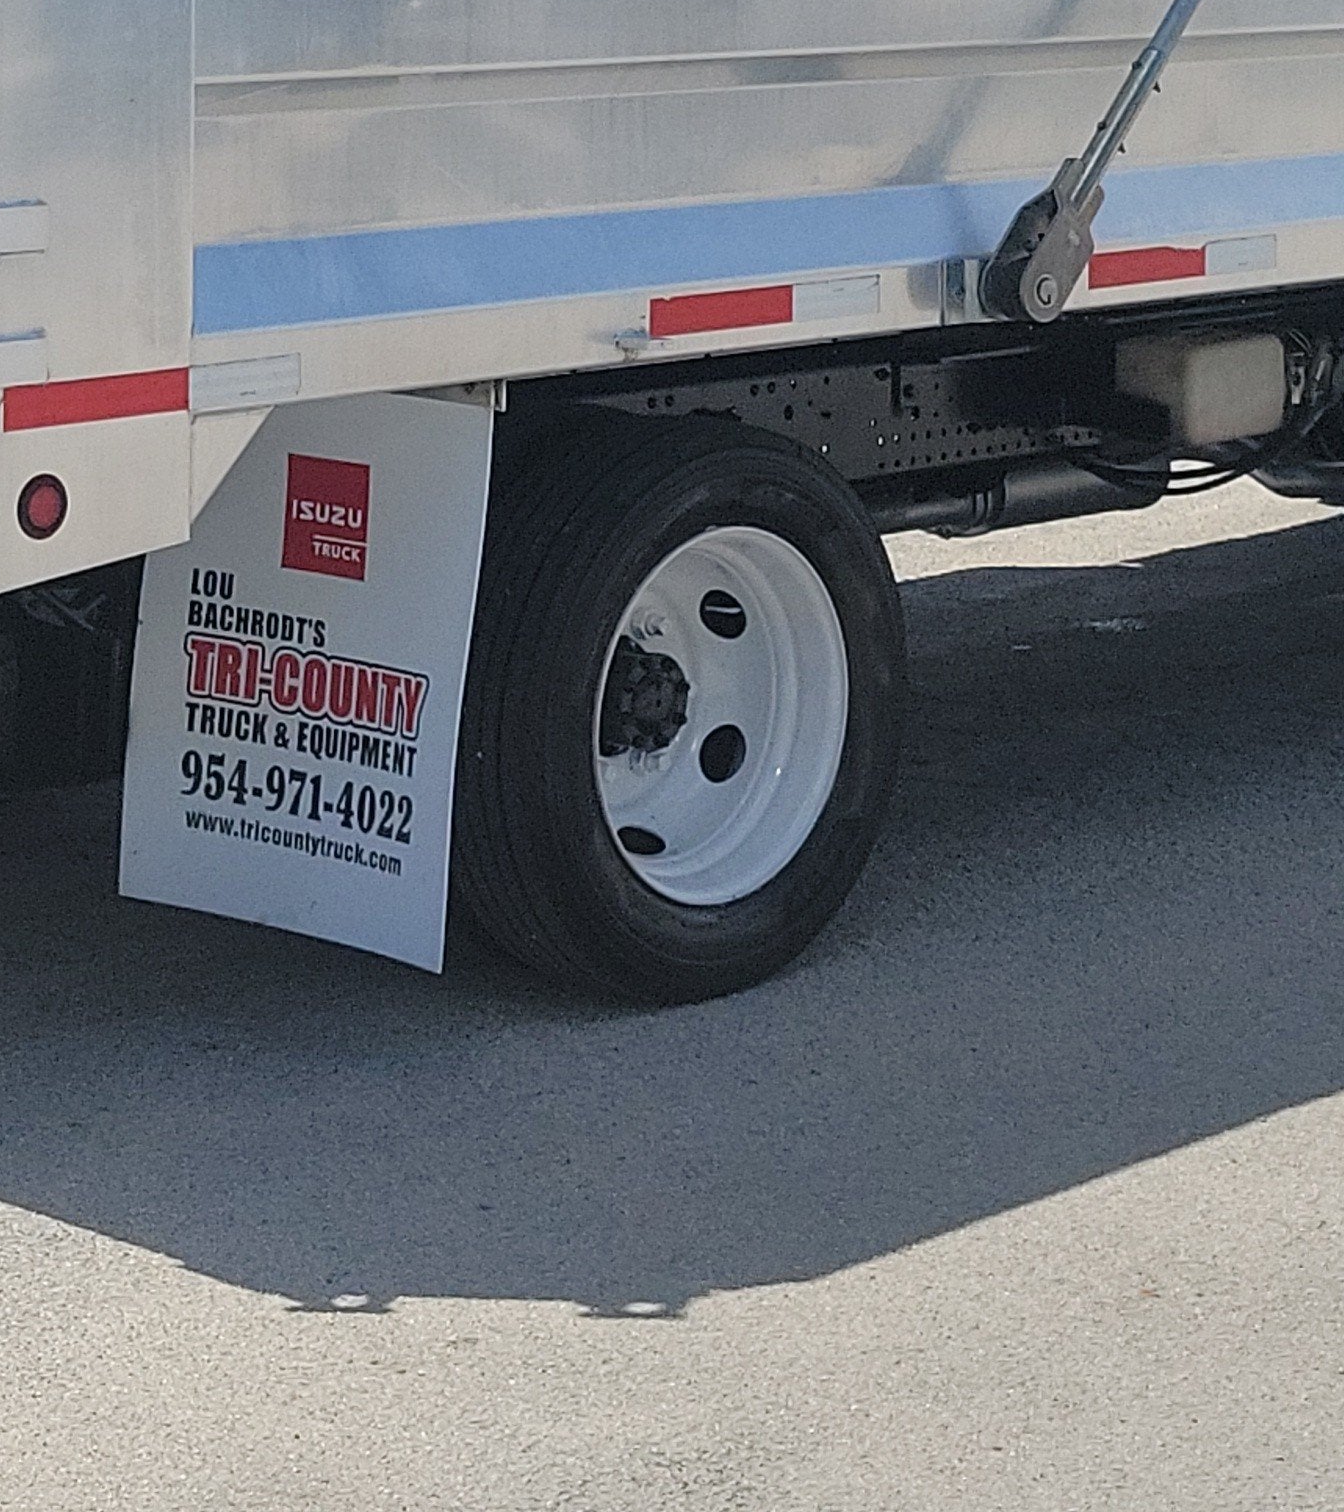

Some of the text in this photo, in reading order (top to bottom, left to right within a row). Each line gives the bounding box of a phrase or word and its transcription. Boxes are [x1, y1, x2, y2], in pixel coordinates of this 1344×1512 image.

[291, 499, 363, 528] ISUZU
[312, 541, 361, 563] TRUCK
[190, 568, 235, 600] LOU
[187, 599, 326, 648] BACHRODT'S
[187, 634, 426, 737] TRI-COUNTY
[185, 701, 418, 778] TRUCK & EQUIPMENT
[180, 749, 414, 845] 954-971-4022
[185, 810, 403, 877] www.tricountytruck.com
